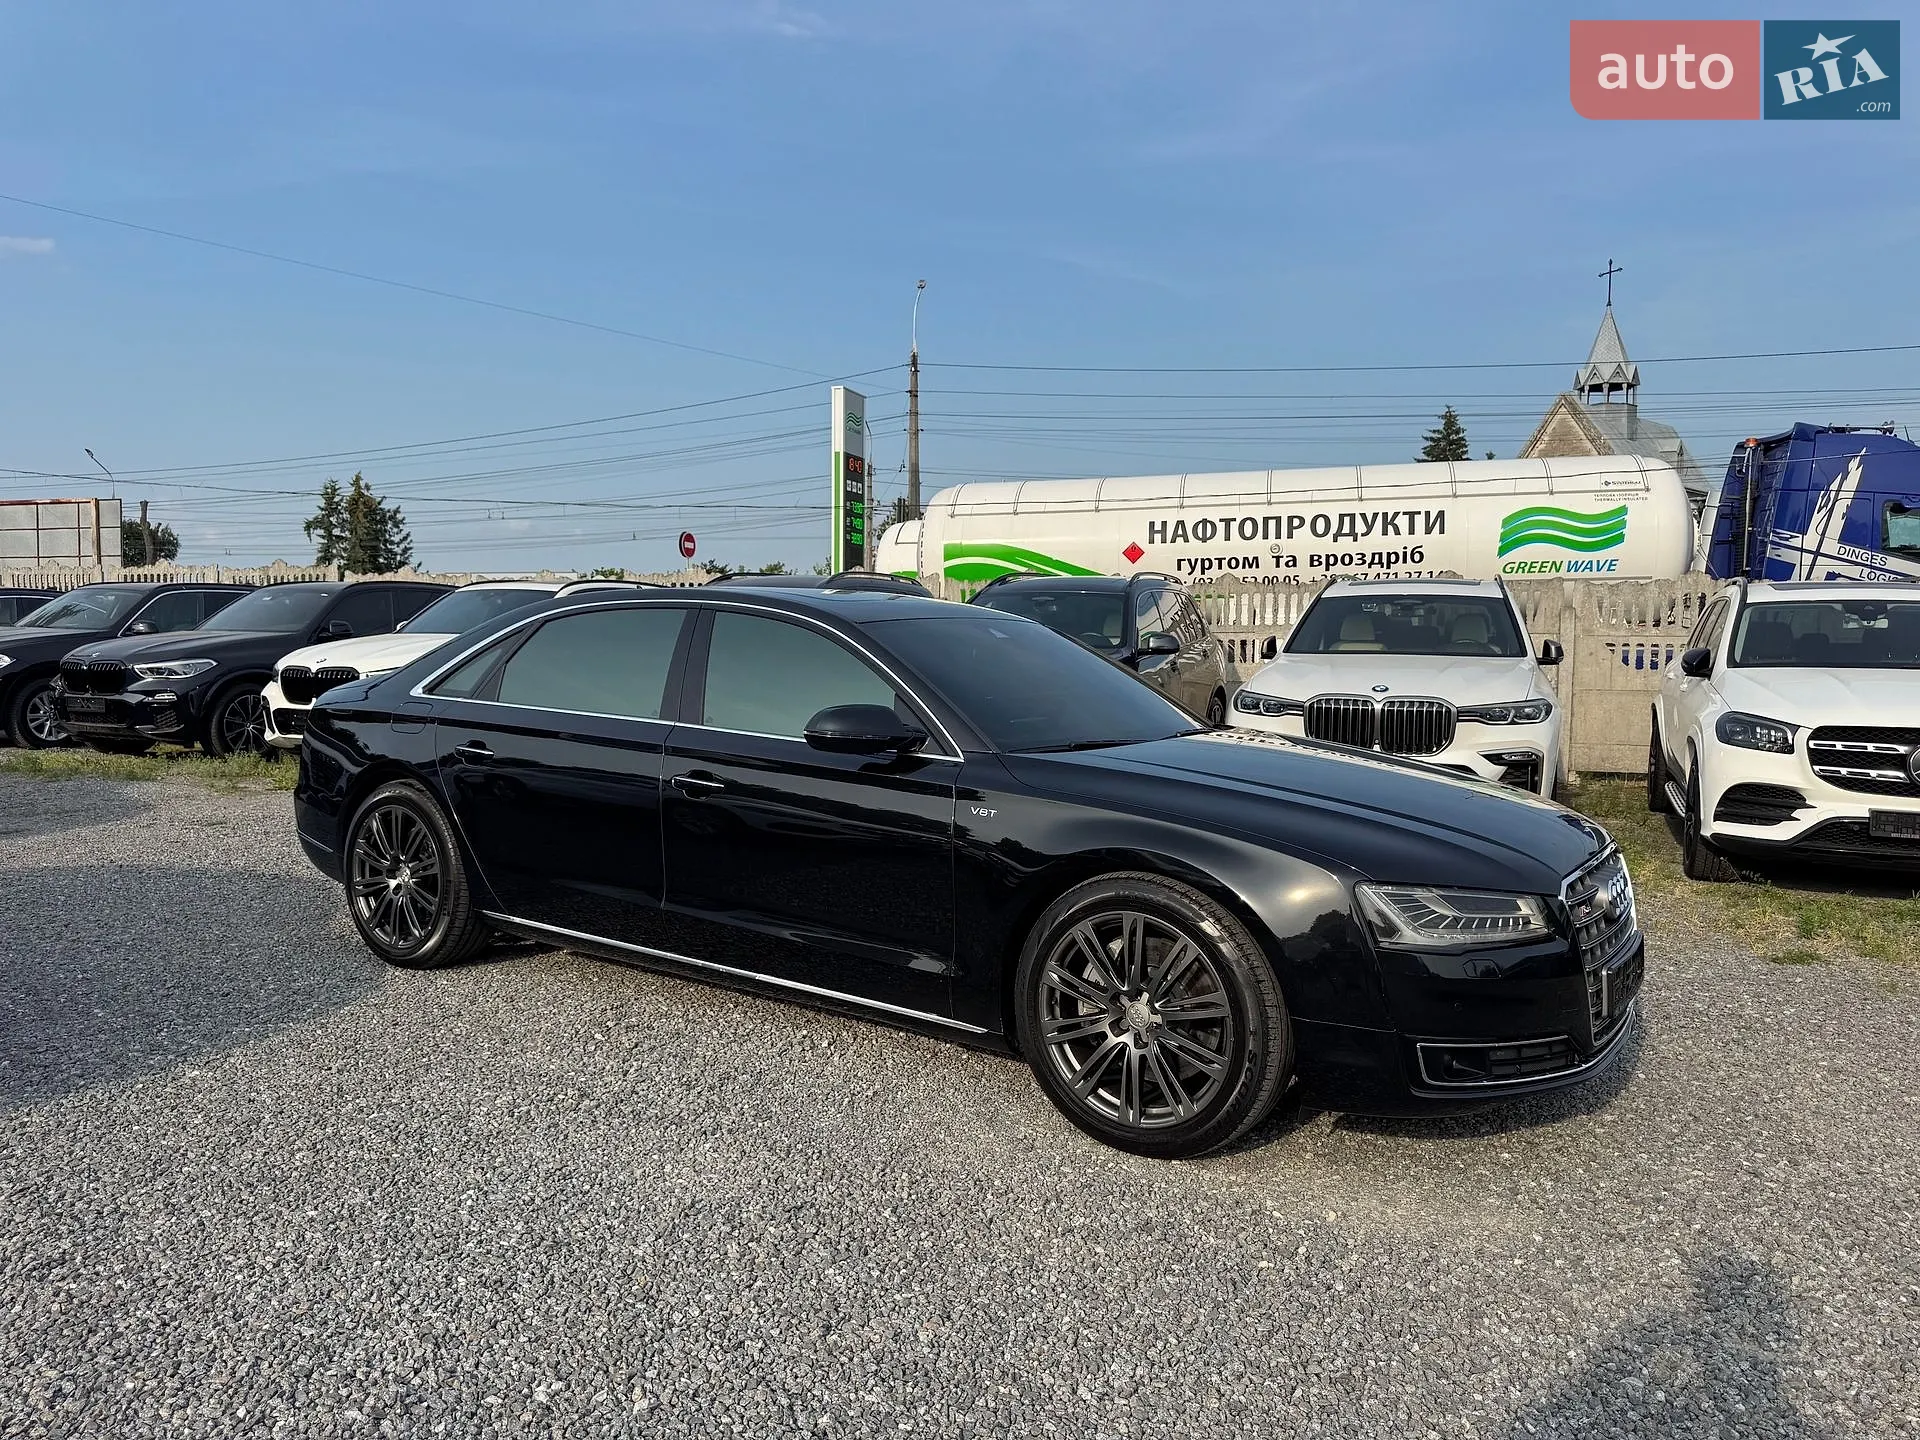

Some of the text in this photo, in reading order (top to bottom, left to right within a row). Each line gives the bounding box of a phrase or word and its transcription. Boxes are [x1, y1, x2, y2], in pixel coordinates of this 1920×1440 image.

[1148, 510, 1445, 544] НАФТОПРОДУКТИ
[1176, 545, 1424, 575] гуртом та вроздріб
[1502, 559, 1619, 574] GREEN WAVE
[1837, 545, 1888, 567] DINGES
[970, 806, 998, 818] V8T
